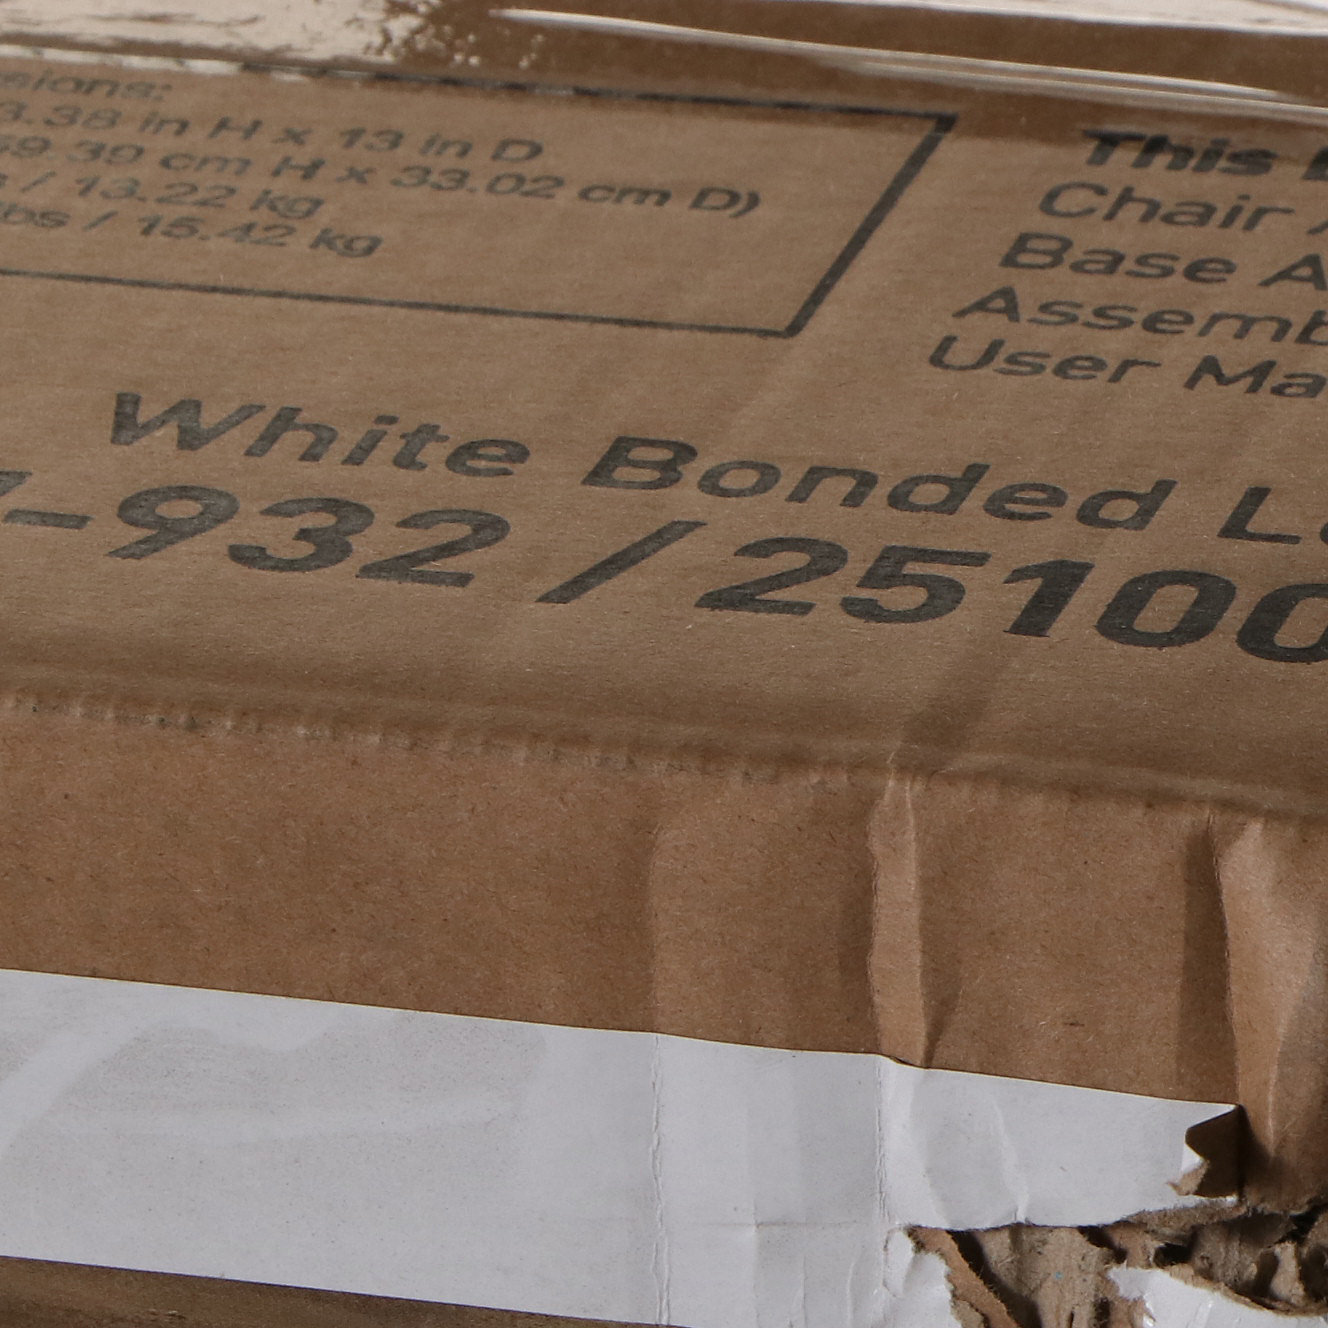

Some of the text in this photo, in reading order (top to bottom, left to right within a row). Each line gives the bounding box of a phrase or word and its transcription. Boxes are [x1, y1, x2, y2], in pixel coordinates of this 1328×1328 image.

[139, 110, 191, 136] in
[208, 116, 262, 140] H
[272, 127, 313, 146] x
[338, 126, 404, 152] 13
[418, 132, 473, 158] in
[490, 138, 544, 162] D
[1082, 128, 1280, 177] This
[20, 170, 57, 193] /
[76, 175, 237, 209] 13.22
[250, 188, 326, 220] kg
[160, 152, 252, 176] cm
[271, 156, 325, 180] H
[336, 166, 376, 184] x
[390, 164, 566, 199] 33.02
[577, 183, 673, 207] cm
[688, 186, 761, 218] D)
[1038, 180, 1296, 233] Chair
[0, 201, 384, 258] bs / 15.42 kg
[999, 231, 1238, 285] Base
[927, 334, 1162, 385] User
[108, 391, 532, 478] White
[581, 434, 1179, 533] Bonded
[534, 520, 708, 605] /
